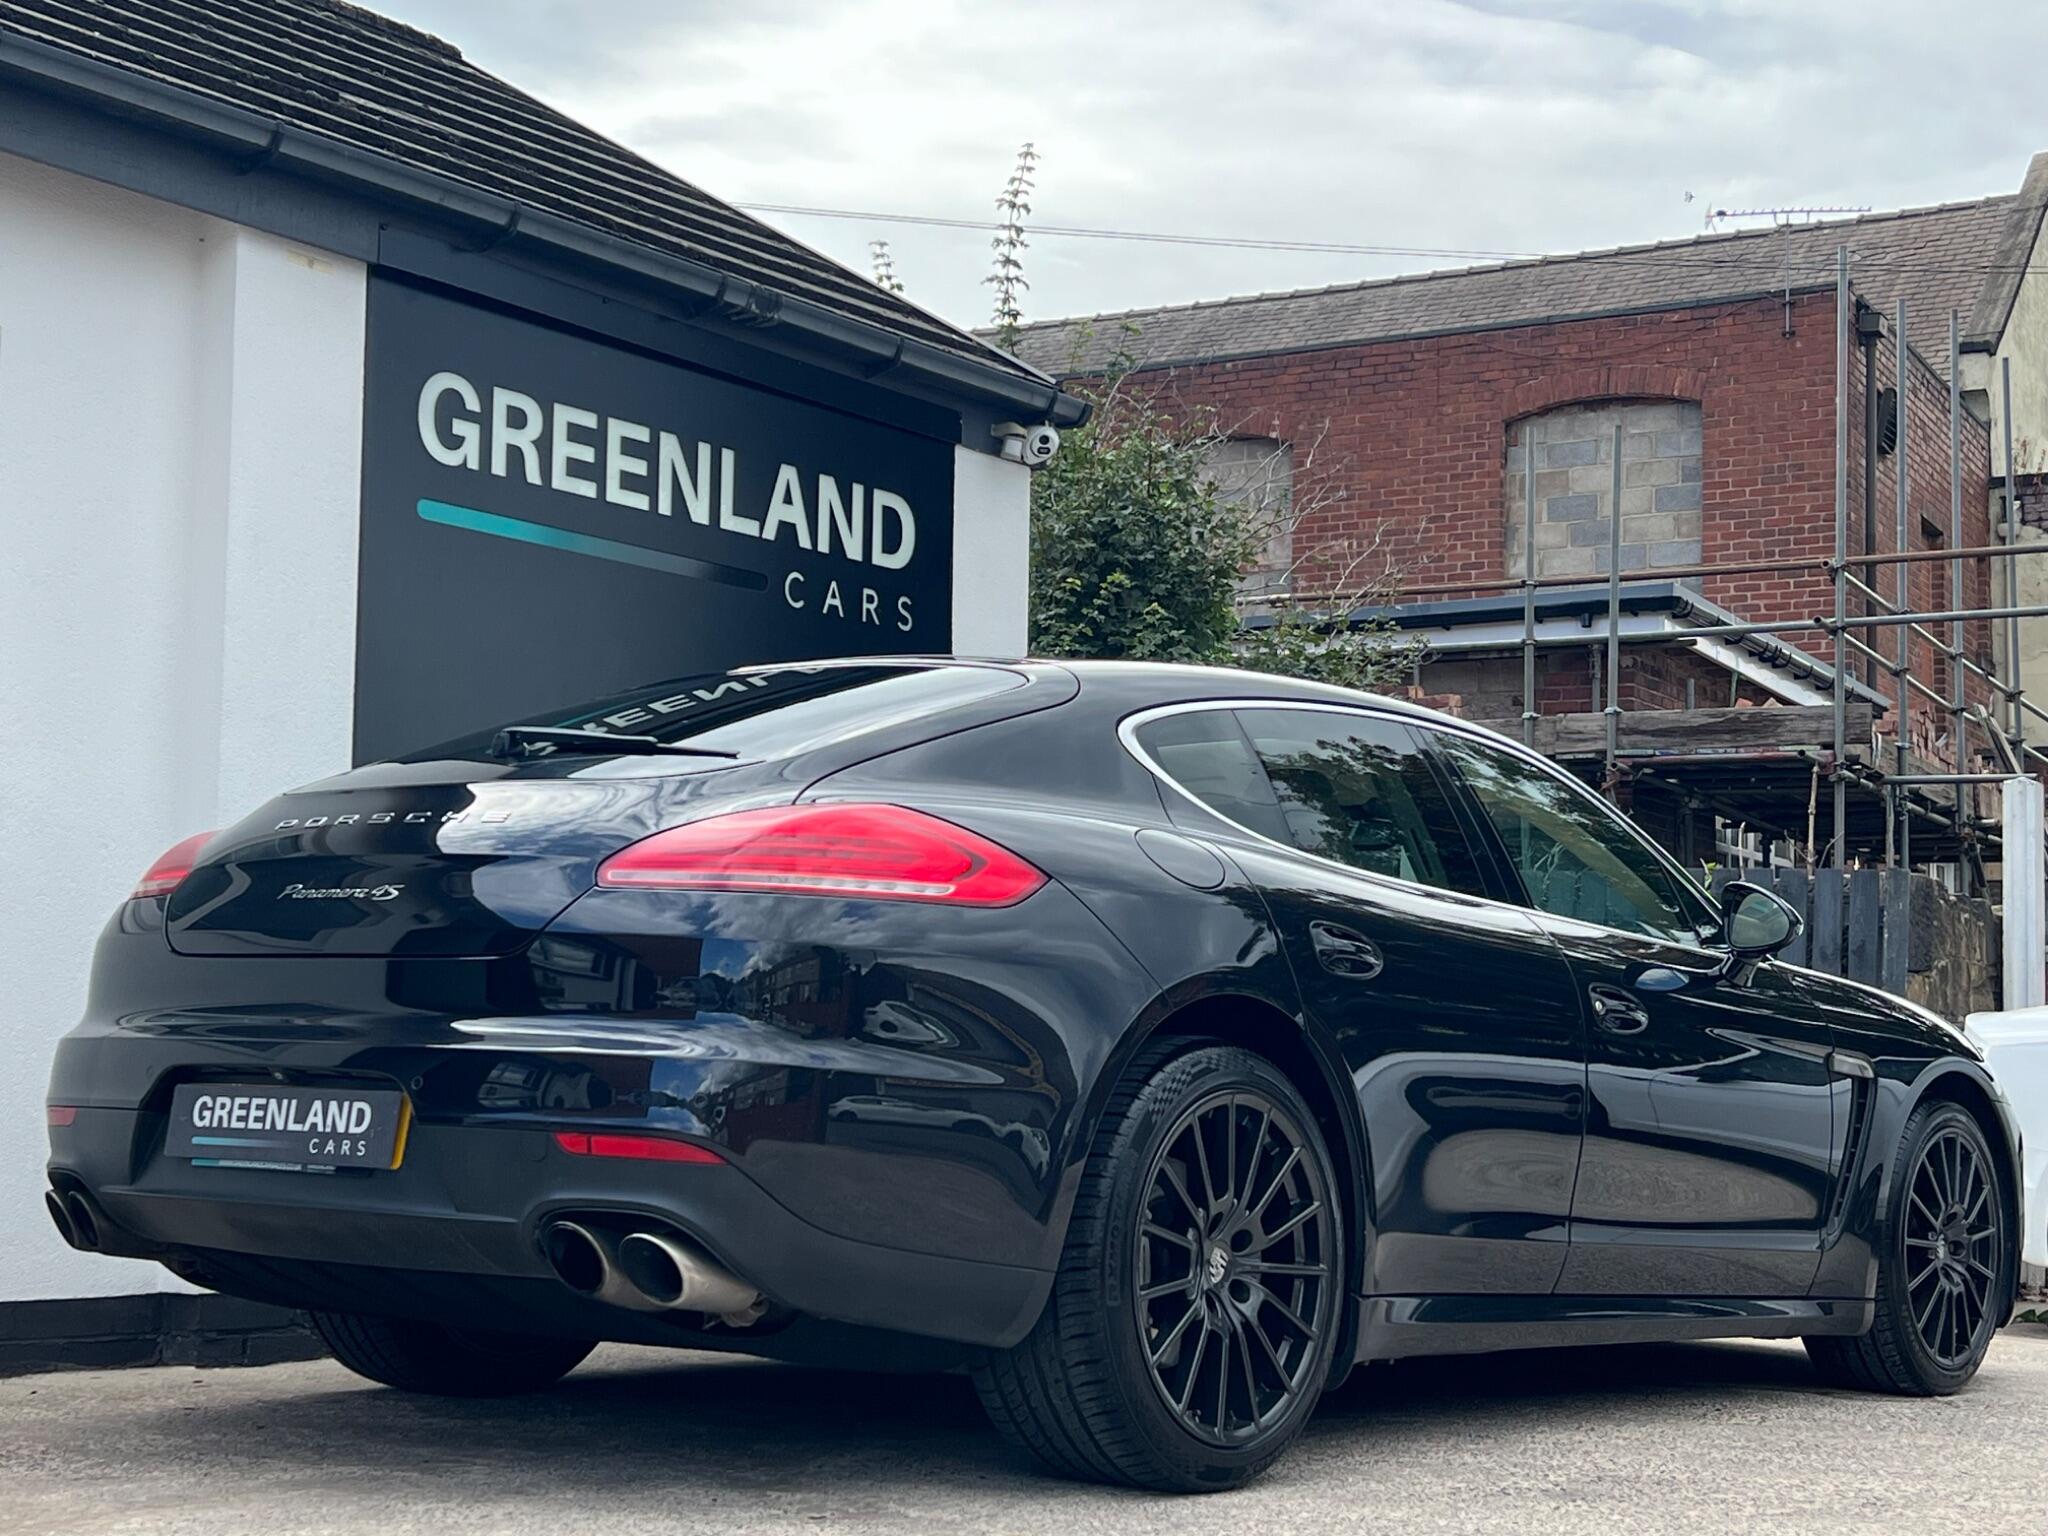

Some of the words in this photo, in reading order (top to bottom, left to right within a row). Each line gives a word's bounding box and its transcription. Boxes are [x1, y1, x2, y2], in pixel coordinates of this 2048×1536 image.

[417, 371, 916, 570] GREENLAND
[784, 571, 914, 632] CARS
[274, 811, 512, 831] PORSCHE
[277, 883, 369, 900] Panamera
[192, 1095, 372, 1135] GREENLAND
[309, 1138, 366, 1156] CARS
